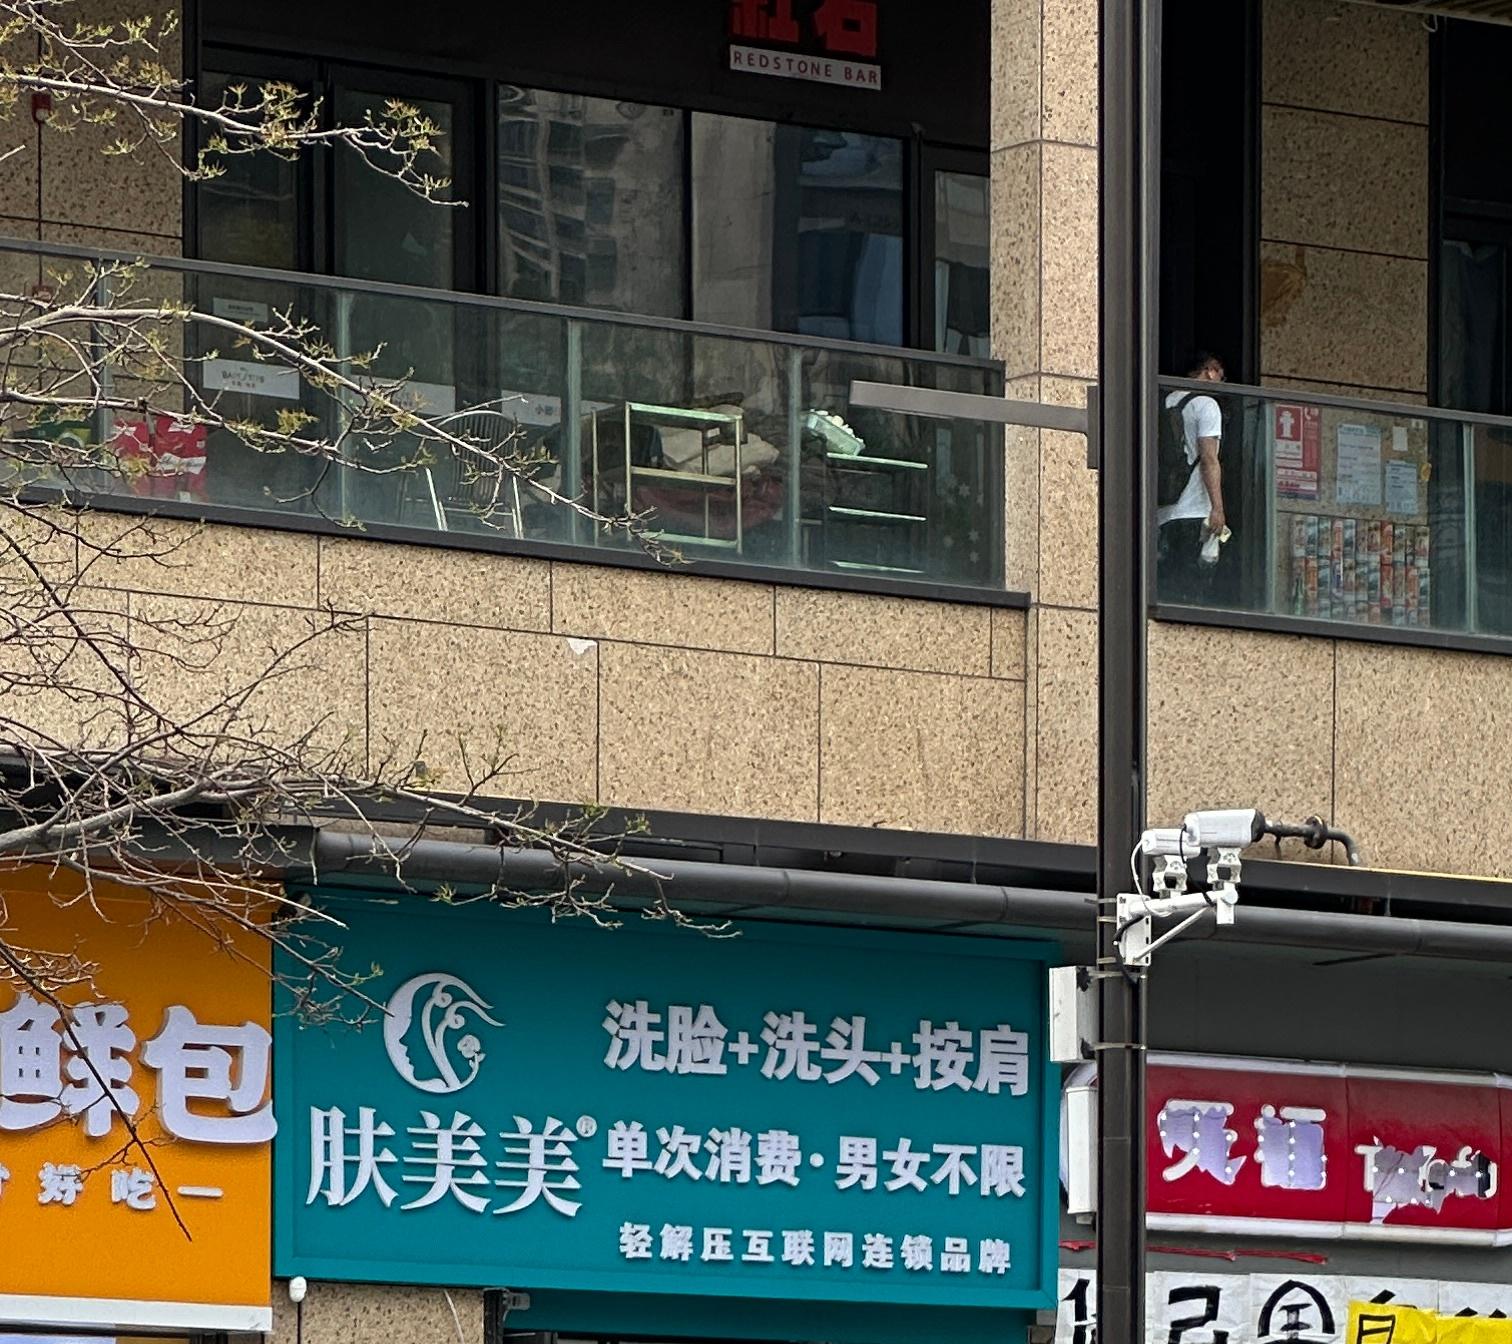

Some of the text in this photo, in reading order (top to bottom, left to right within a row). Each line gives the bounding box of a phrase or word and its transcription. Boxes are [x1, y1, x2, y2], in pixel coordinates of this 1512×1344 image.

[733, 51, 877, 84] REDSTONE BAR
[0, 992, 277, 1145] 鲜包
[601, 1000, 1029, 1097] 洗脸+洗头+按肩
[306, 1105, 583, 1217] 肤美美
[619, 1222, 1012, 1275] 轻解压互联网连锁品牌
